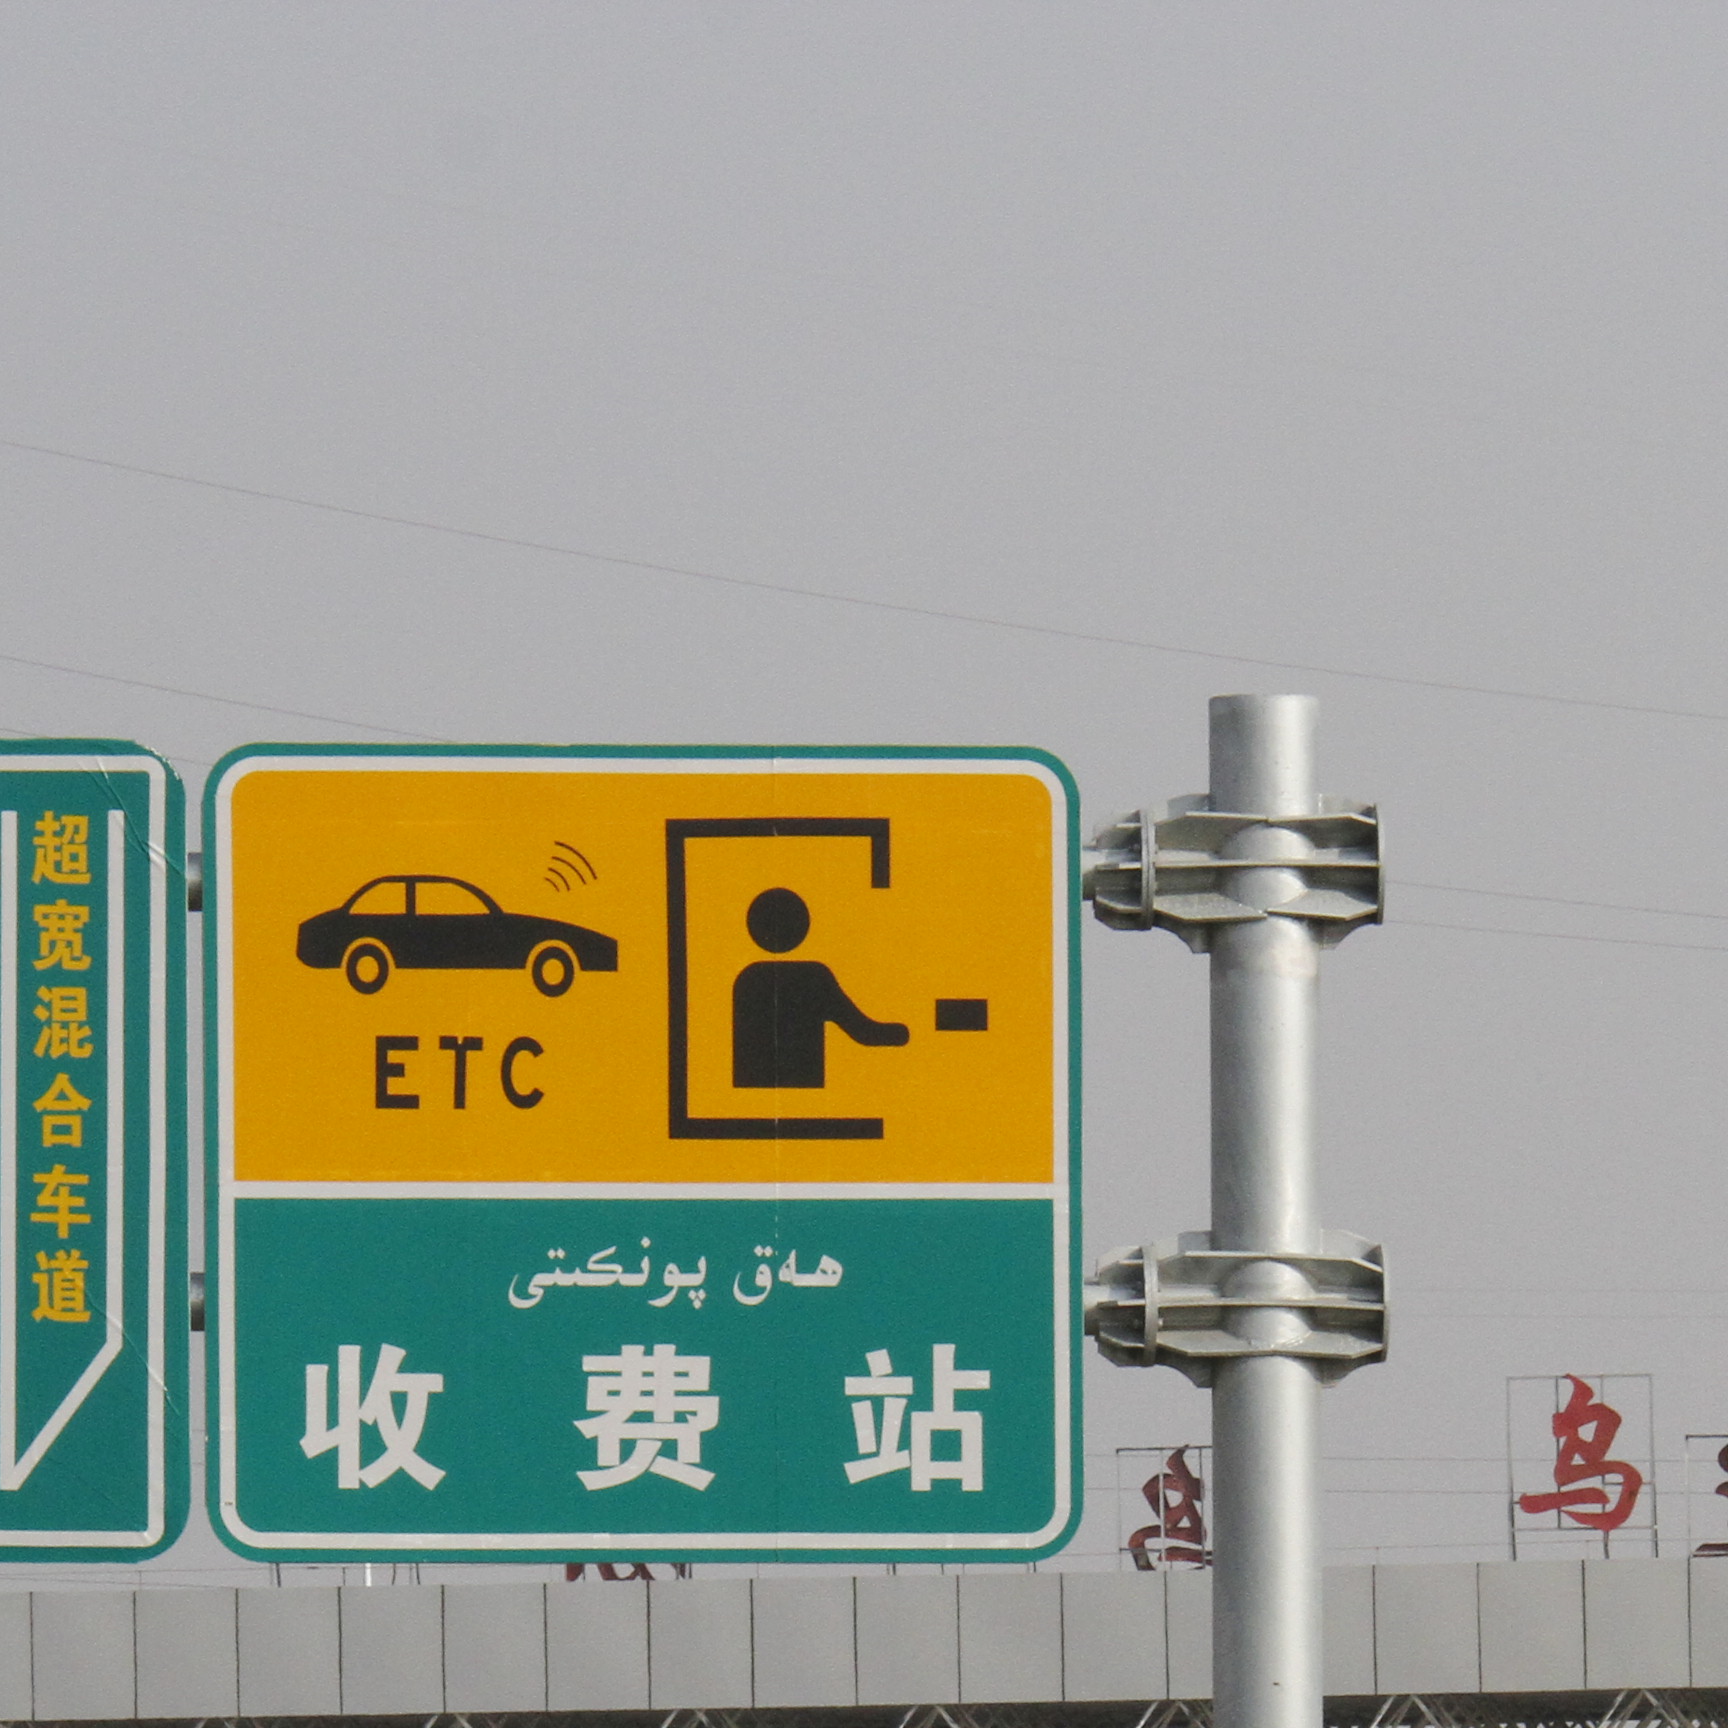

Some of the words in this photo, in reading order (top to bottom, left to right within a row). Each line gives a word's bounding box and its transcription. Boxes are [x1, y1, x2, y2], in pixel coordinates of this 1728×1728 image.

[31, 811, 94, 1323] 超宽混合车道
[374, 1035, 546, 1110] ETC
[298, 1341, 992, 1492] 收费站
